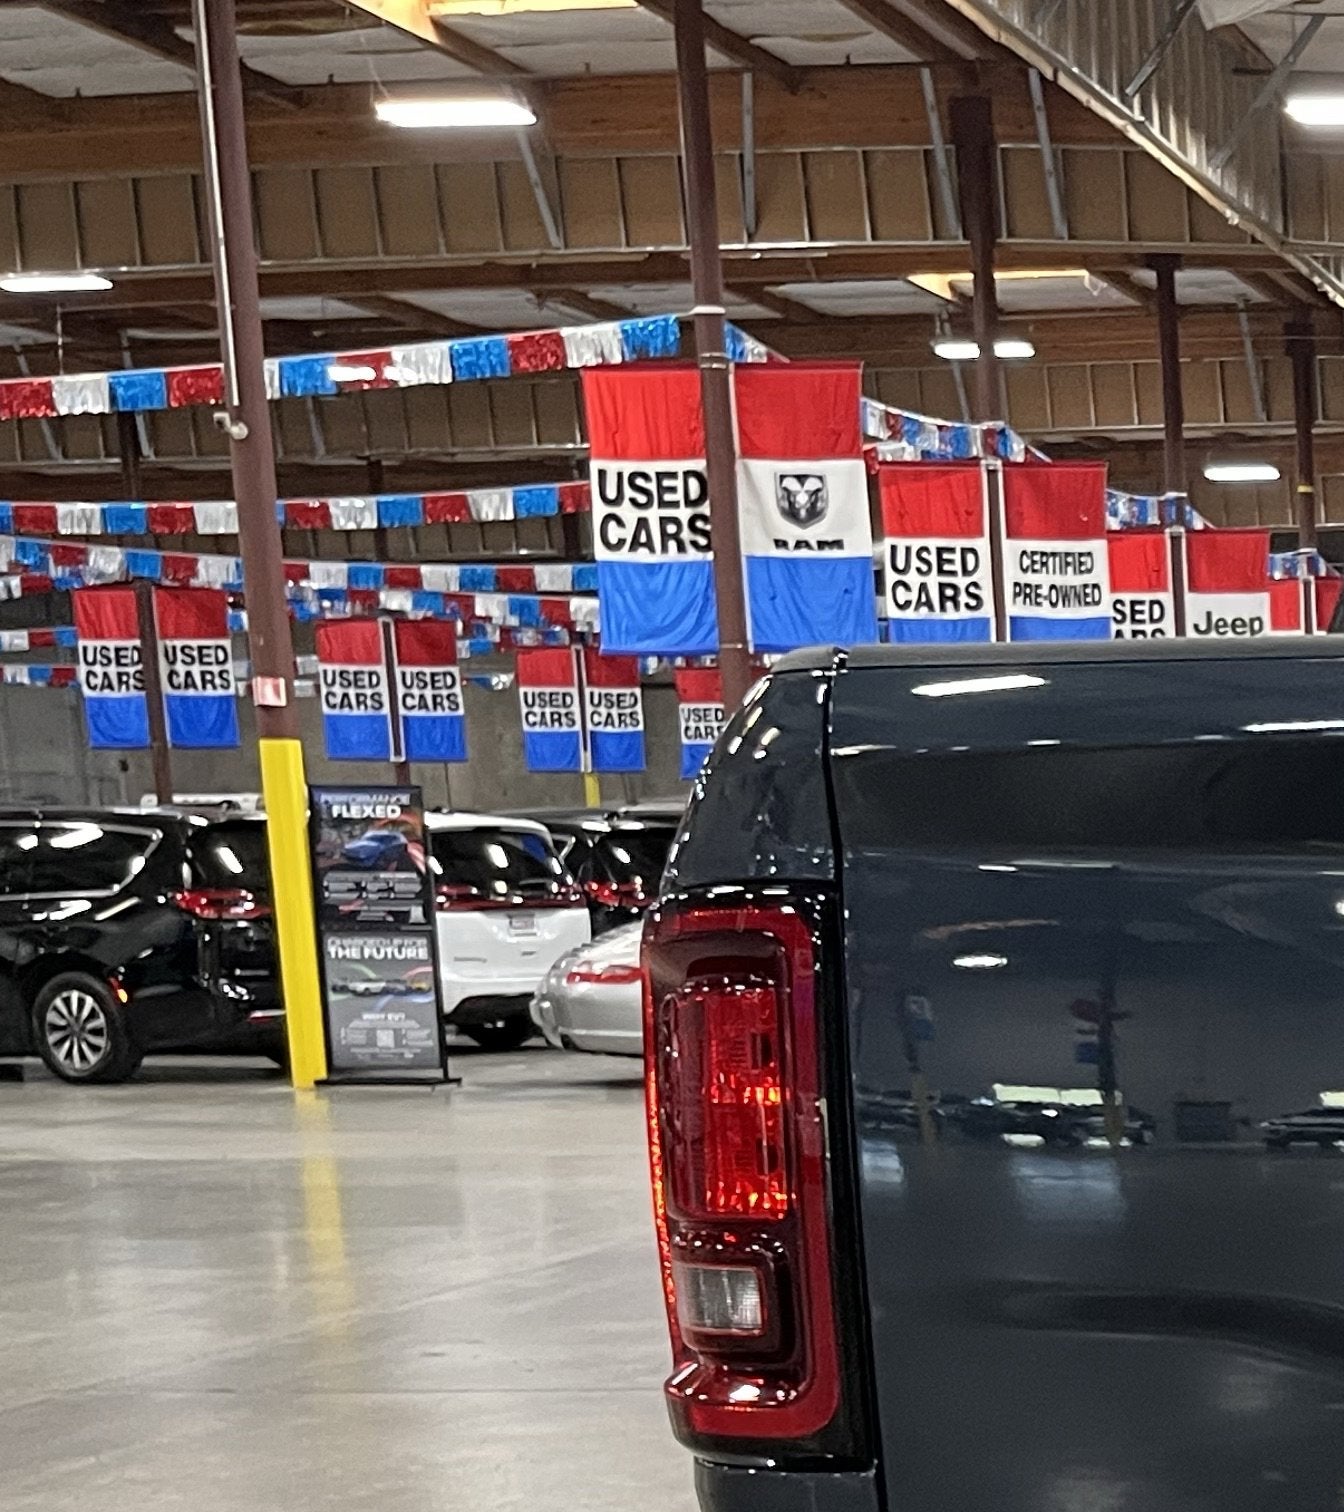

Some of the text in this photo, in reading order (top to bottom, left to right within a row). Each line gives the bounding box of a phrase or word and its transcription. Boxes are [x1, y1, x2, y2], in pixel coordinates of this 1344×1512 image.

[597, 468, 709, 510] USED
[599, 512, 712, 555] CARS
[773, 538, 845, 552] RAM
[889, 544, 981, 578] USED
[1019, 549, 1095, 576] CERTIFIED
[890, 579, 985, 613] CARS
[1012, 581, 1102, 609] PRE-OWNED
[1112, 599, 1166, 625] SED
[1193, 610, 1264, 638] Jeep
[82, 645, 143, 667] USED
[163, 644, 230, 667] USED
[85, 669, 147, 692] CARS
[167, 669, 232, 691] CARS
[322, 669, 381, 689] USED
[401, 670, 457, 690] USED
[324, 691, 384, 712] CARS
[401, 692, 460, 712] CARS
[523, 691, 575, 709] USED
[589, 691, 640, 710] USED
[524, 711, 577, 728] CARS
[589, 710, 641, 729] CARS
[681, 707, 725, 723] USED
[331, 804, 402, 819] FLEXED
[329, 946, 429, 960] THE FUTURE
